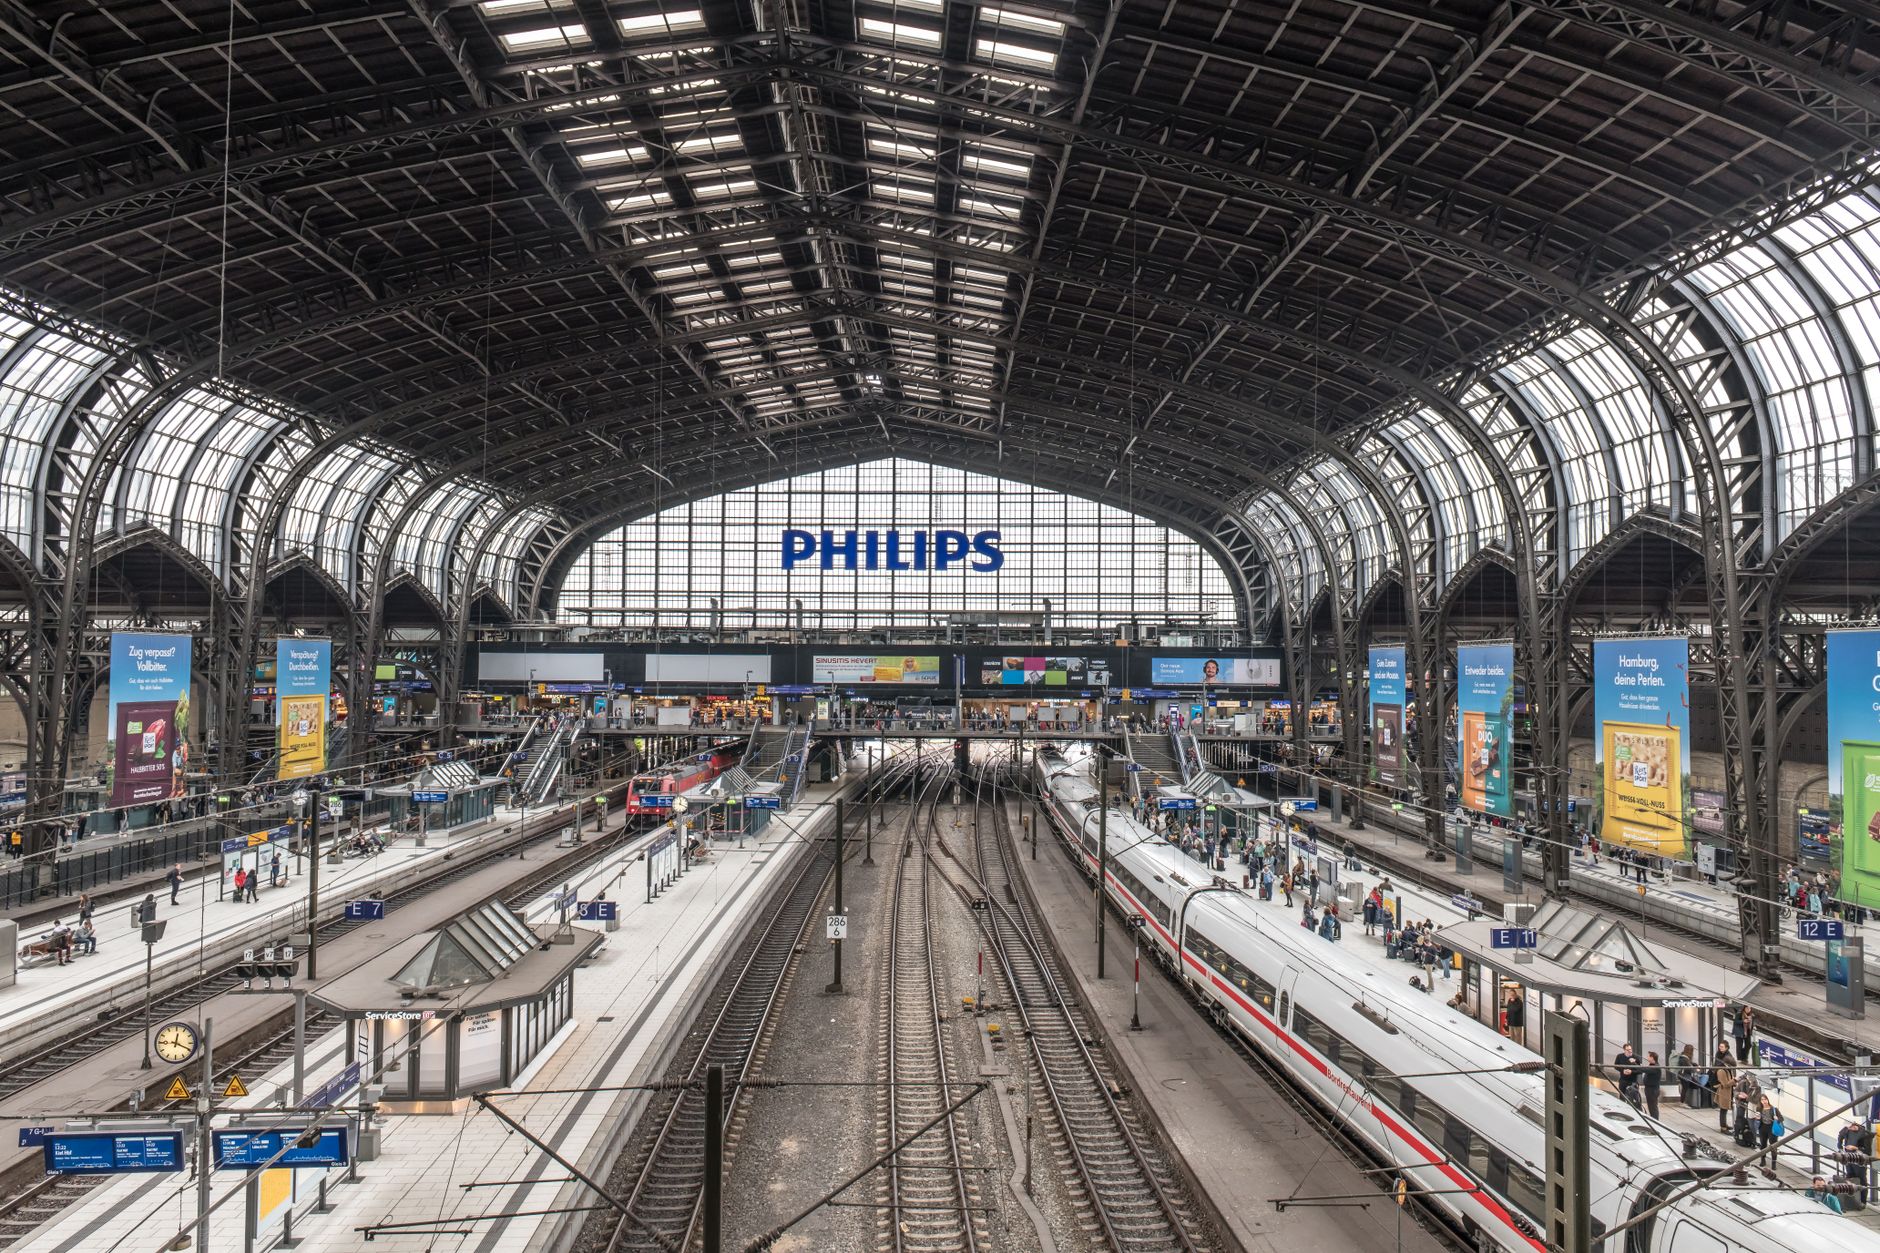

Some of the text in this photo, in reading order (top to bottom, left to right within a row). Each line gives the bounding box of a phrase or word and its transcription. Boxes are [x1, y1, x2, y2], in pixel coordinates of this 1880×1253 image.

[782, 529, 1004, 572] PHILIPS
[129, 645, 176, 660] Zug verpasst?
[137, 660, 168, 672] Vollbitter.
[1619, 654, 1659, 671] Hamburg,
[1615, 671, 1665, 686] deine Perlen.
[1478, 730, 1493, 743] DUO
[352, 902, 381, 915] E 7
[579, 903, 608, 917] 8 E
[829, 917, 846, 926] 286
[834, 927, 840, 936] 6
[1803, 923, 1836, 936] 12 E
[1501, 931, 1534, 944] E 11
[1662, 1000, 1713, 1008] ServiceStore
[365, 1011, 421, 1021] ServiceStore
[1327, 1067, 1372, 1113] Bordrestaurant
